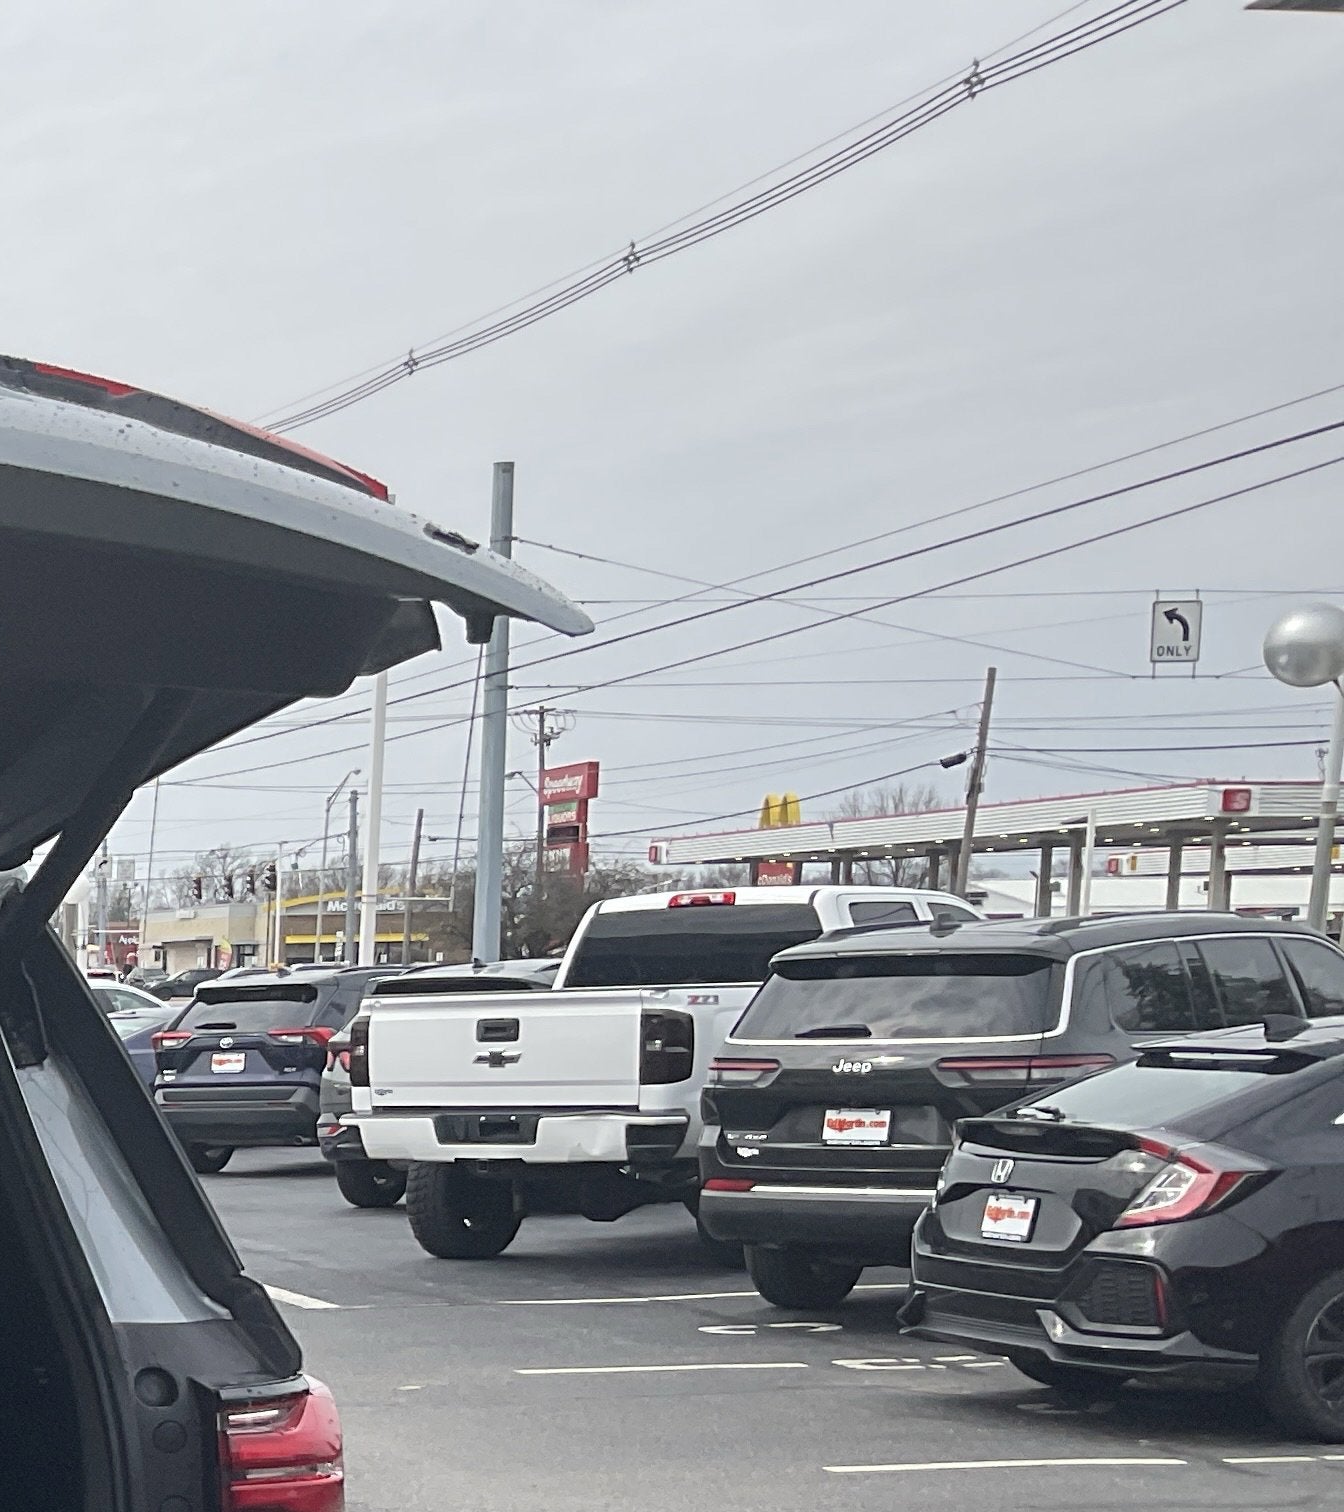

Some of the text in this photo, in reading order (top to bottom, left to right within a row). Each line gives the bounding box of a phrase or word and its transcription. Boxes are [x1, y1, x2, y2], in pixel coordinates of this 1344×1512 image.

[1156, 645, 1192, 657] ONLY
[543, 775, 583, 799] Speedway
[757, 874, 792, 886] cDonald's
[687, 995, 719, 1005] Z71
[832, 1058, 872, 1074] Jeep
